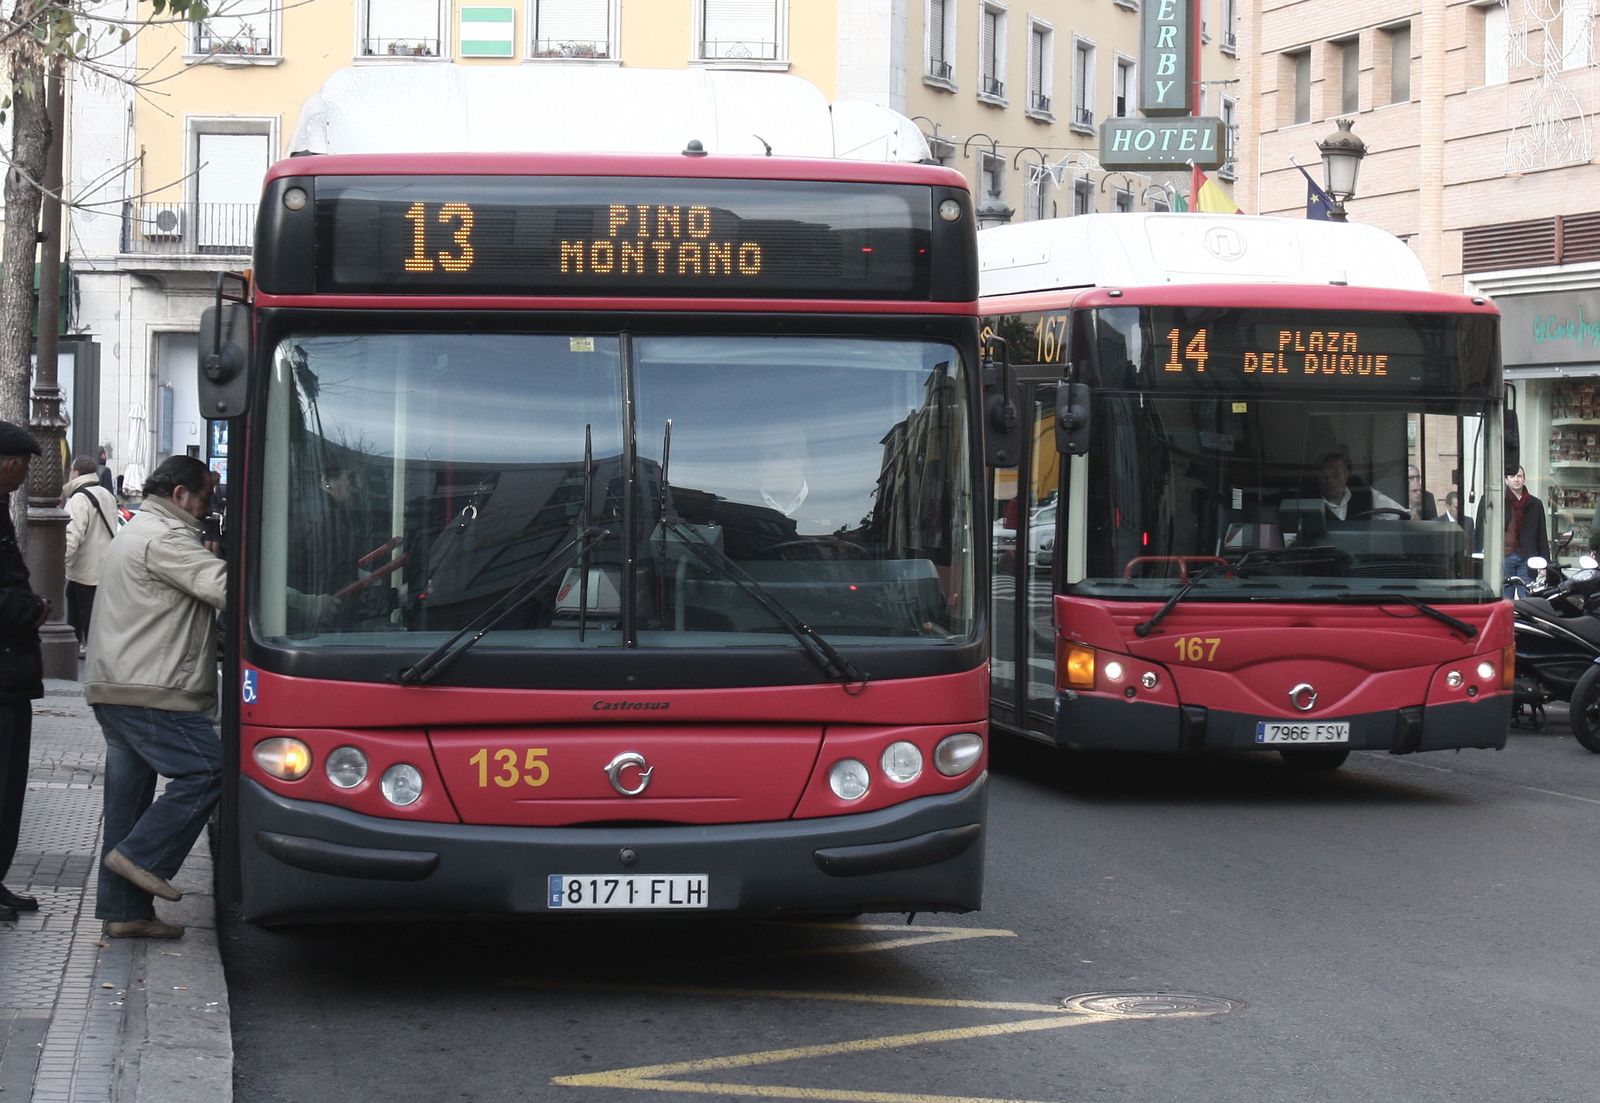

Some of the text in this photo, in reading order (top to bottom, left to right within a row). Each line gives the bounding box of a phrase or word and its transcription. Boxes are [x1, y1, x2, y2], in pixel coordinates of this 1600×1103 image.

[1112, 128, 1215, 152] HOTEL
[609, 204, 711, 238] PINO
[405, 202, 475, 272] 13
[560, 240, 762, 275] MONTANO
[1036, 315, 1068, 362] 167
[1165, 328, 1209, 372] 14
[1279, 330, 1359, 353] PLAZA
[1244, 352, 1388, 376] DEL DUQUE
[1174, 637, 1221, 662] 167
[592, 700, 671, 711] Castrosua
[1270, 726, 1311, 741] 7966
[1315, 725, 1344, 740] FSV
[469, 748, 550, 788] 135
[567, 879, 634, 905] 8171
[651, 880, 702, 905] FLH
